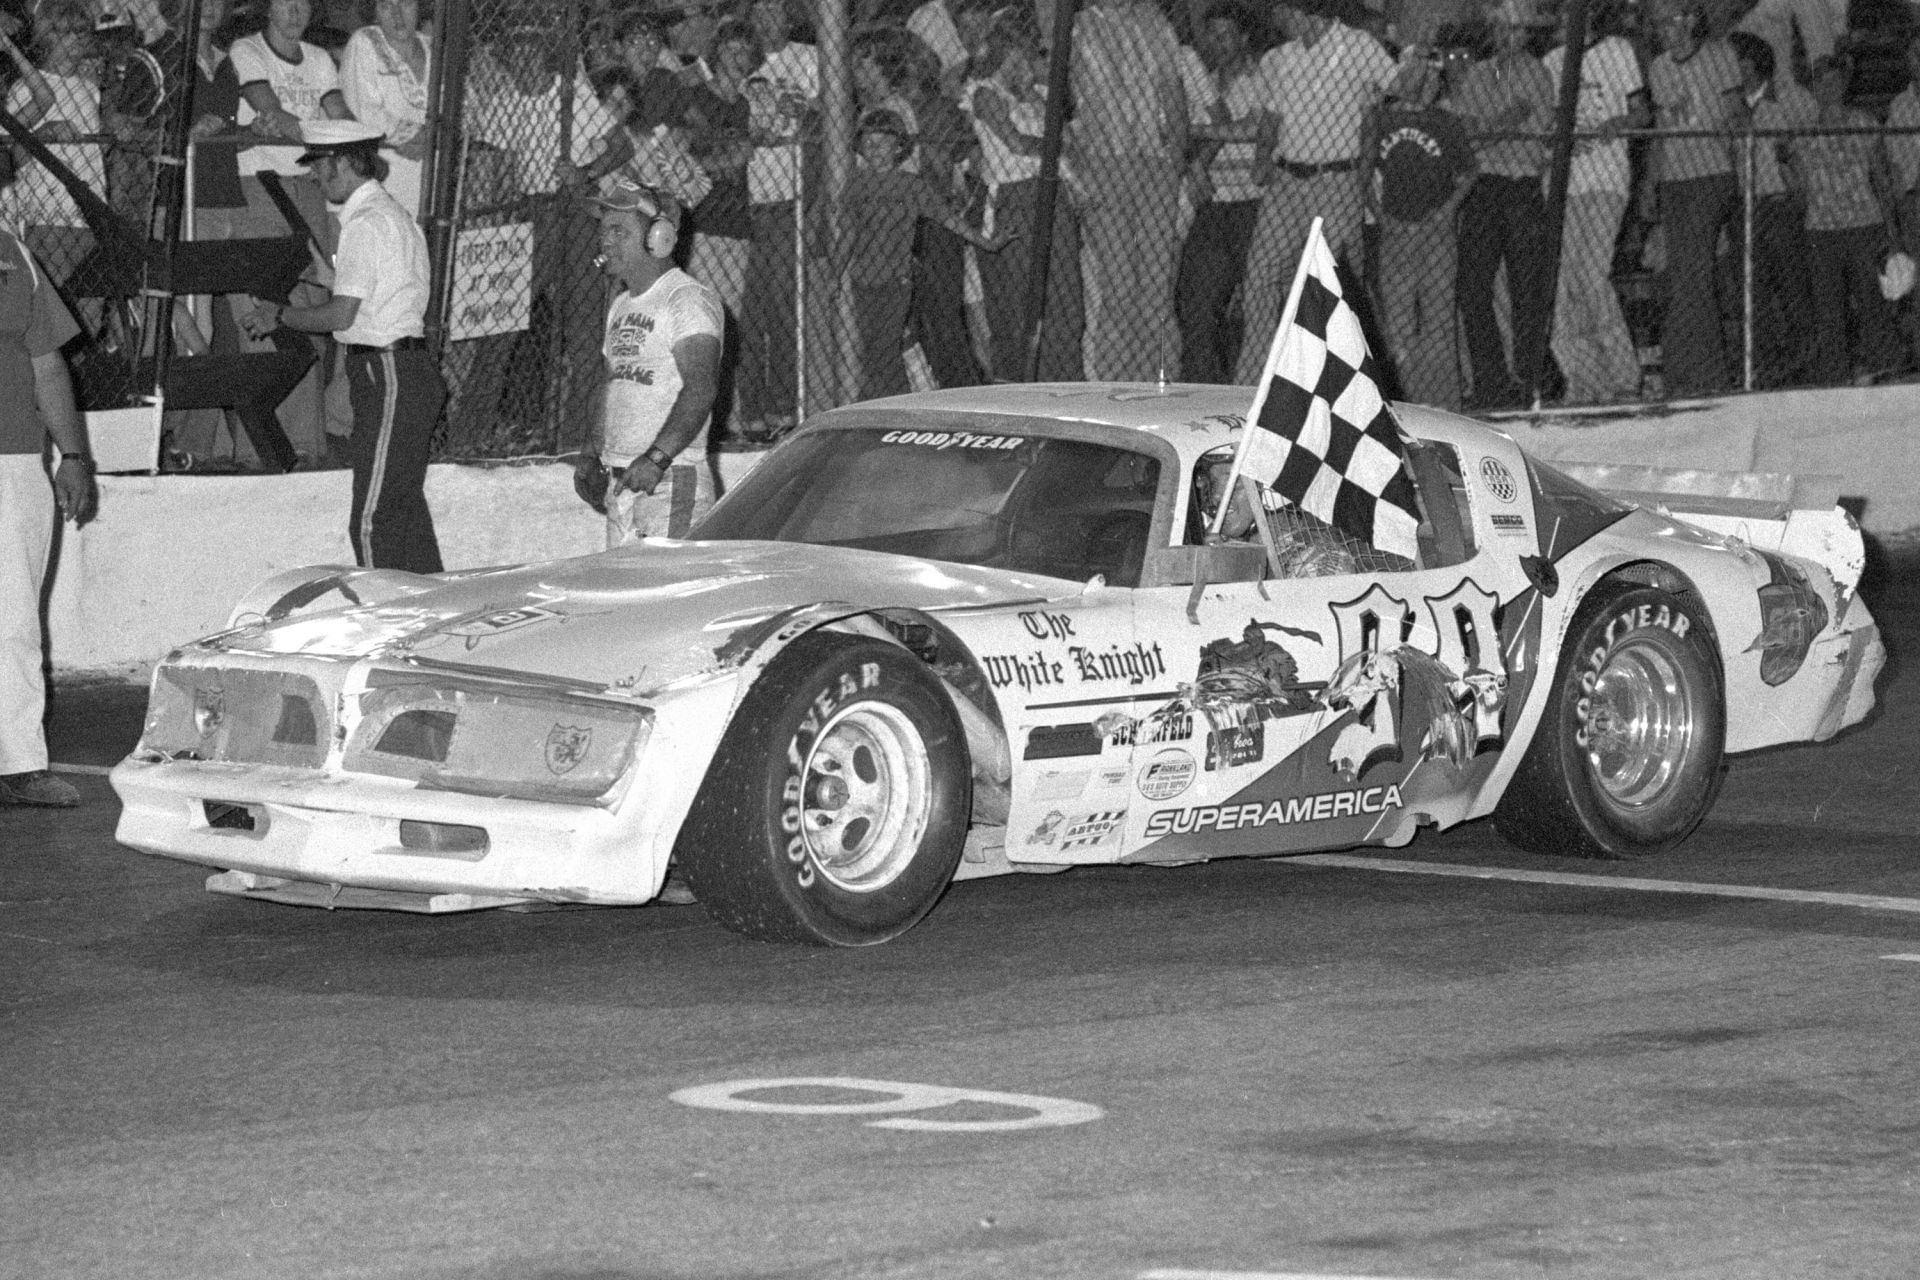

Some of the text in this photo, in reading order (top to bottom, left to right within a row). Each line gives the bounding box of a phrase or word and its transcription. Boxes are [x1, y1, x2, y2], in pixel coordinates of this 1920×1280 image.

[1017, 610, 1076, 642] The
[982, 641, 1167, 694] White Knight
[1143, 784, 1403, 838] SUPERAMERICA
